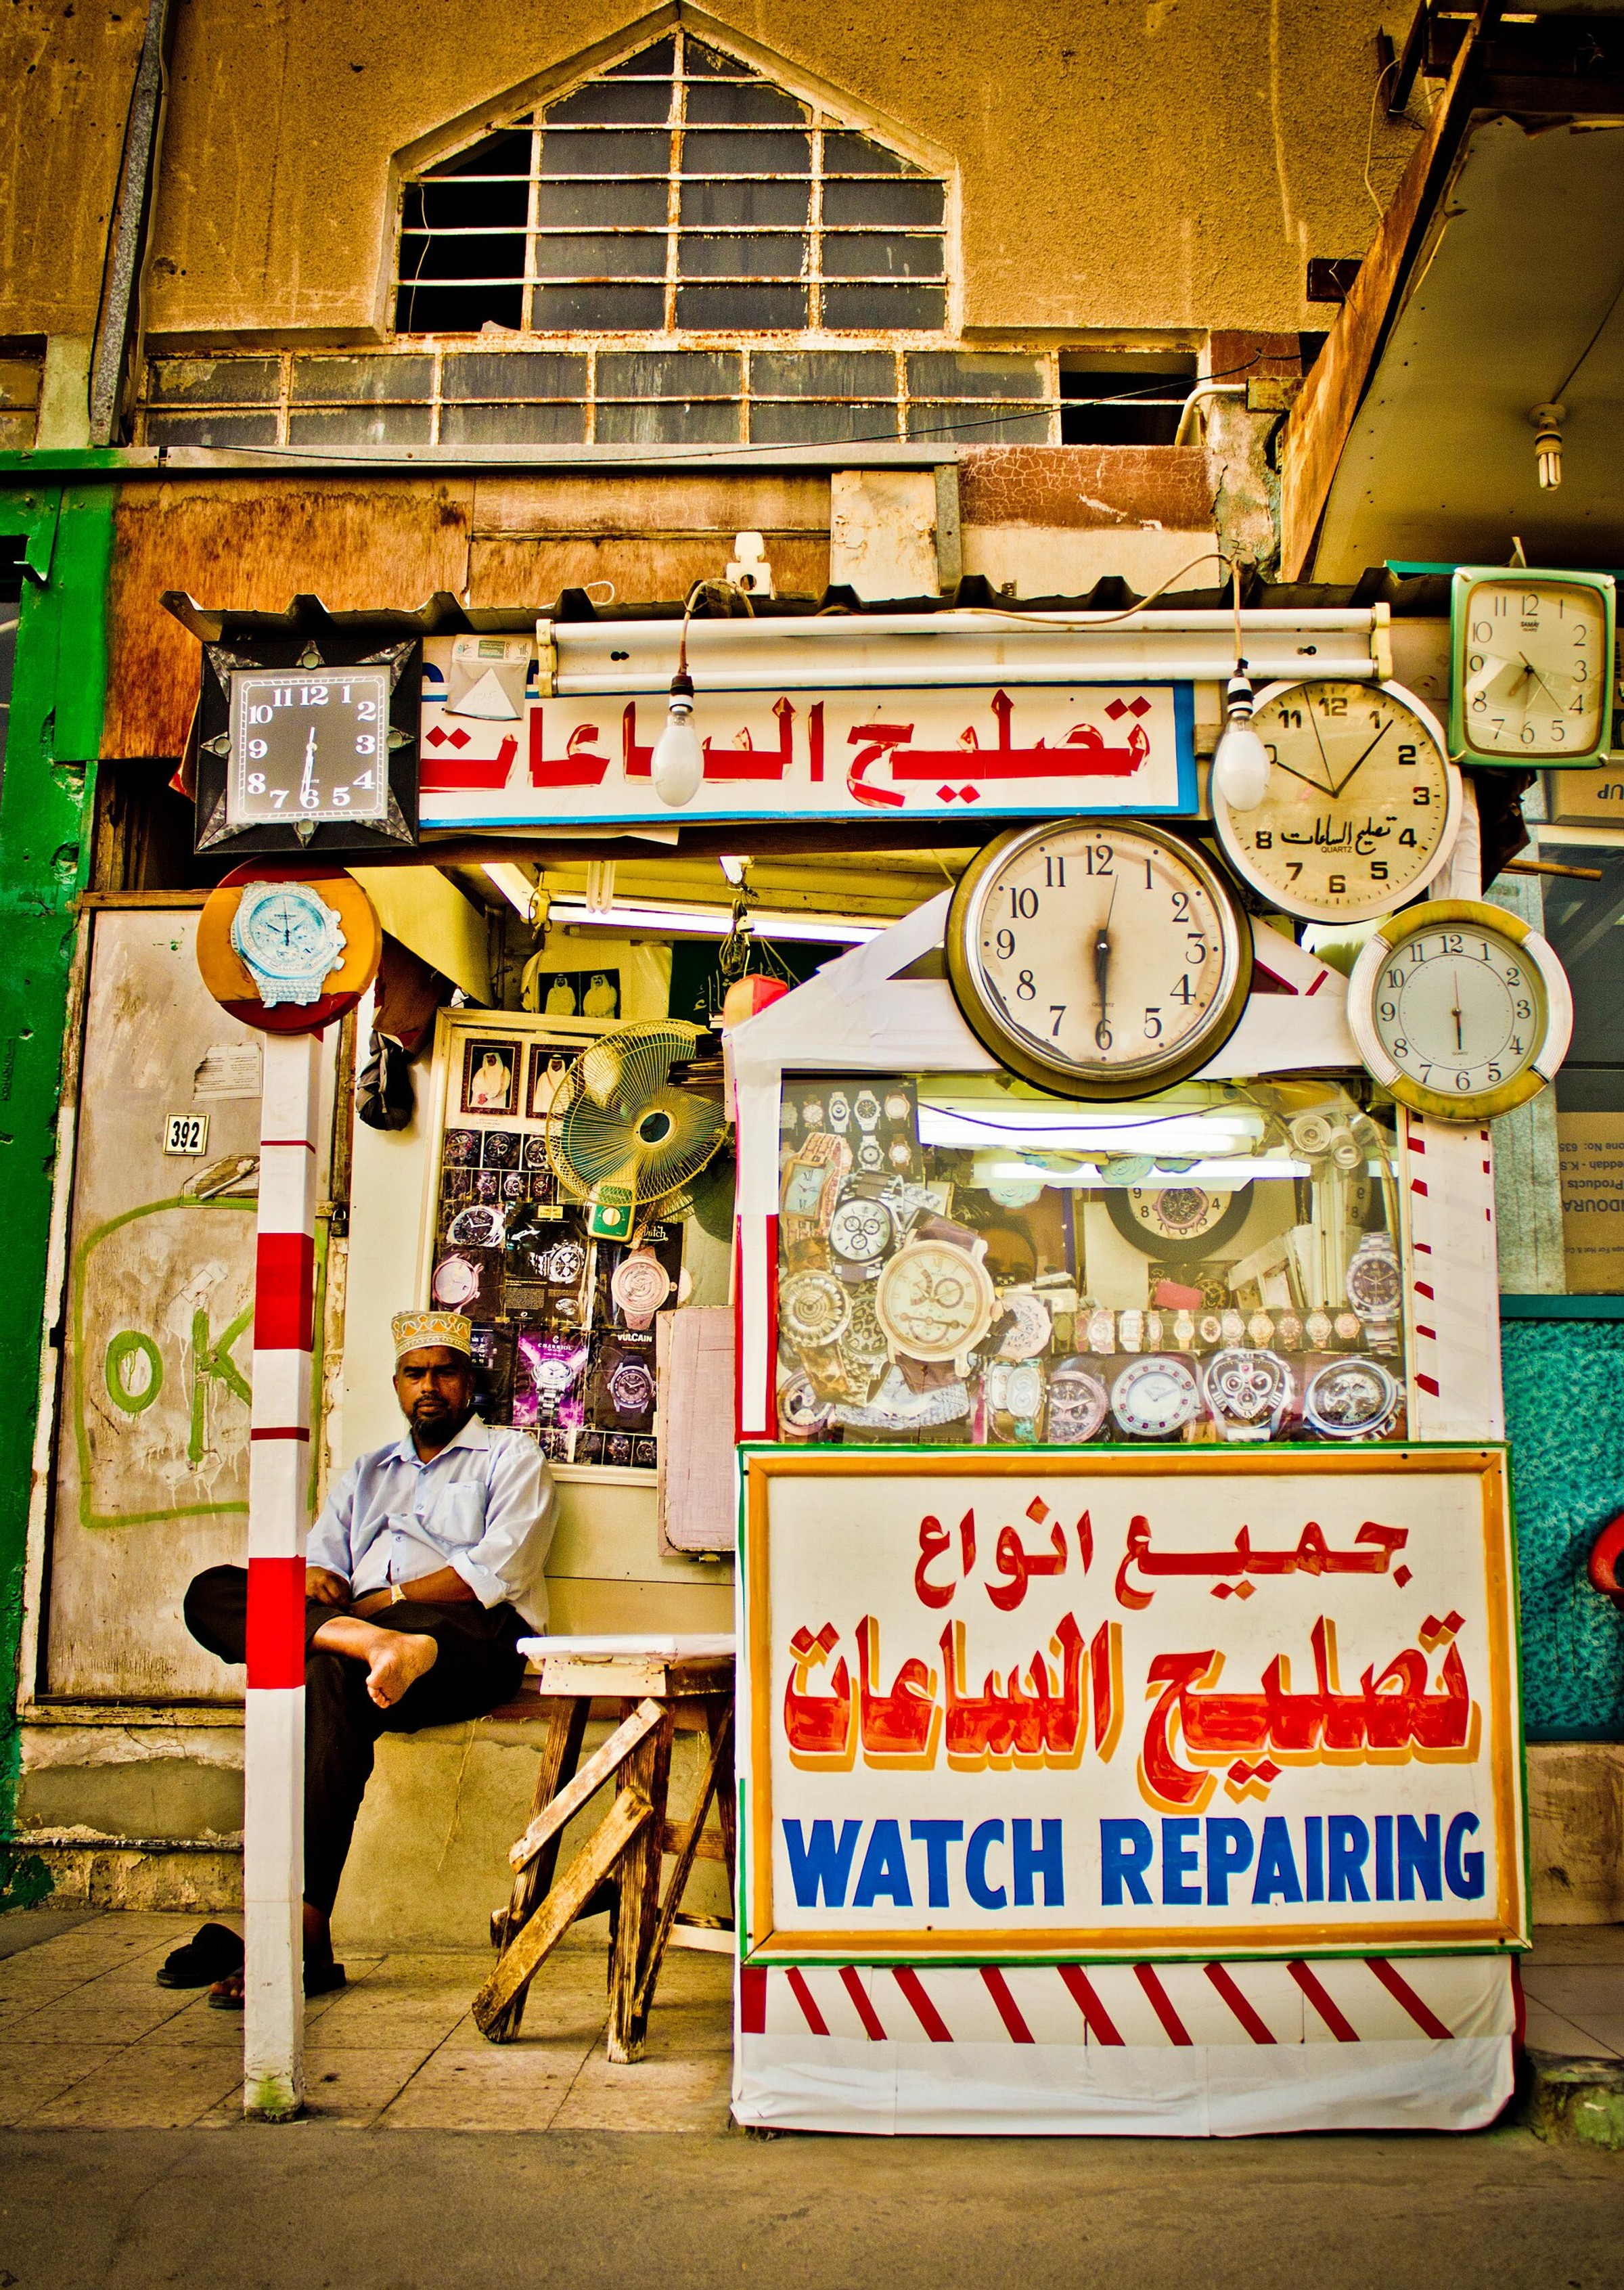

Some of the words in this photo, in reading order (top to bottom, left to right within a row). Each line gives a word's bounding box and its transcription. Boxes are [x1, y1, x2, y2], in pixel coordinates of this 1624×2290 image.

[1495, 596, 1506, 616] 11
[1522, 594, 1539, 616] 12
[1559, 599, 1564, 619] 1
[1472, 621, 1493, 643] 10
[1573, 625, 1587, 646] 2
[1470, 655, 1484, 671] 9
[1573, 660, 1587, 682] 3
[273, 688, 293, 707] 11
[300, 686, 329, 705] 12
[342, 685, 352, 703] 1
[1472, 690, 1487, 712] 8
[248, 704, 273, 724] 10
[357, 701, 376, 721] 2
[1319, 698, 1348, 716] 12
[1569, 694, 1584, 715] 4
[1278, 710, 1302, 728] 11
[1369, 711, 1381, 729] 1
[1491, 719, 1505, 740] 7
[1520, 721, 1535, 744] 6
[1551, 720, 1564, 741] 5
[248, 739, 268, 759] 9
[355, 735, 376, 754] 3
[847, 689, 1152, 807] تصليح
[1398, 745, 1416, 765] 2
[248, 773, 266, 794] 8
[353, 770, 375, 789] 4
[270, 790, 290, 808] 7
[302, 789, 319, 809] 6
[332, 787, 351, 806] 5
[1413, 786, 1430, 805] 3
[1597, 784, 1624, 799] UP
[1256, 830, 1272, 849] 8
[1281, 814, 1352, 845] الساعات
[1399, 828, 1417, 847] 4
[1085, 845, 1114, 876] 12
[1370, 861, 1388, 880] 5
[1045, 856, 1065, 888] 11
[1144, 858, 1152, 890] 1
[1286, 862, 1303, 880] 7
[1329, 875, 1346, 893] 6
[1010, 887, 1039, 919] 10
[1171, 892, 1190, 923] 2
[996, 928, 1016, 960] 9
[1186, 933, 1206, 964] 3
[1409, 943, 1425, 962] 11
[1440, 935, 1464, 953] 12
[1481, 943, 1491, 961] 1
[1016, 969, 1037, 1001] 8
[1387, 968, 1405, 988] 10
[1506, 968, 1520, 987] 2
[1170, 974, 1196, 1006] 4
[1380, 1002, 1396, 1022] 9
[1517, 1000, 1531, 1019] 3
[1050, 1006, 1067, 1037] 7
[1144, 1008, 1163, 1039] 5
[1095, 1019, 1112, 1050] 6
[1393, 1038, 1409, 1058] 8
[1509, 1035, 1525, 1055] 4
[1419, 1064, 1433, 1083] 7
[1456, 1071, 1470, 1091] 6
[1488, 1063, 1502, 1081] 5
[171, 1121, 200, 1148] 392
[1568, 1180, 1623, 1190] Products
[1140, 1206, 1149, 1217] 8
[1212, 1198, 1220, 1210] 4
[617, 1333, 652, 1342] VULCAIN
[106, 1307, 254, 1464] OK
[914, 1495, 1093, 1610] انواع
[1116, 1514, 1413, 1611] جميع
[784, 1611, 1123, 1773] الساعات
[1137, 1610, 1482, 1815] تصليح
[782, 1818, 1064, 1910] WATCH
[1100, 1811, 1485, 1906] REPAIRING
